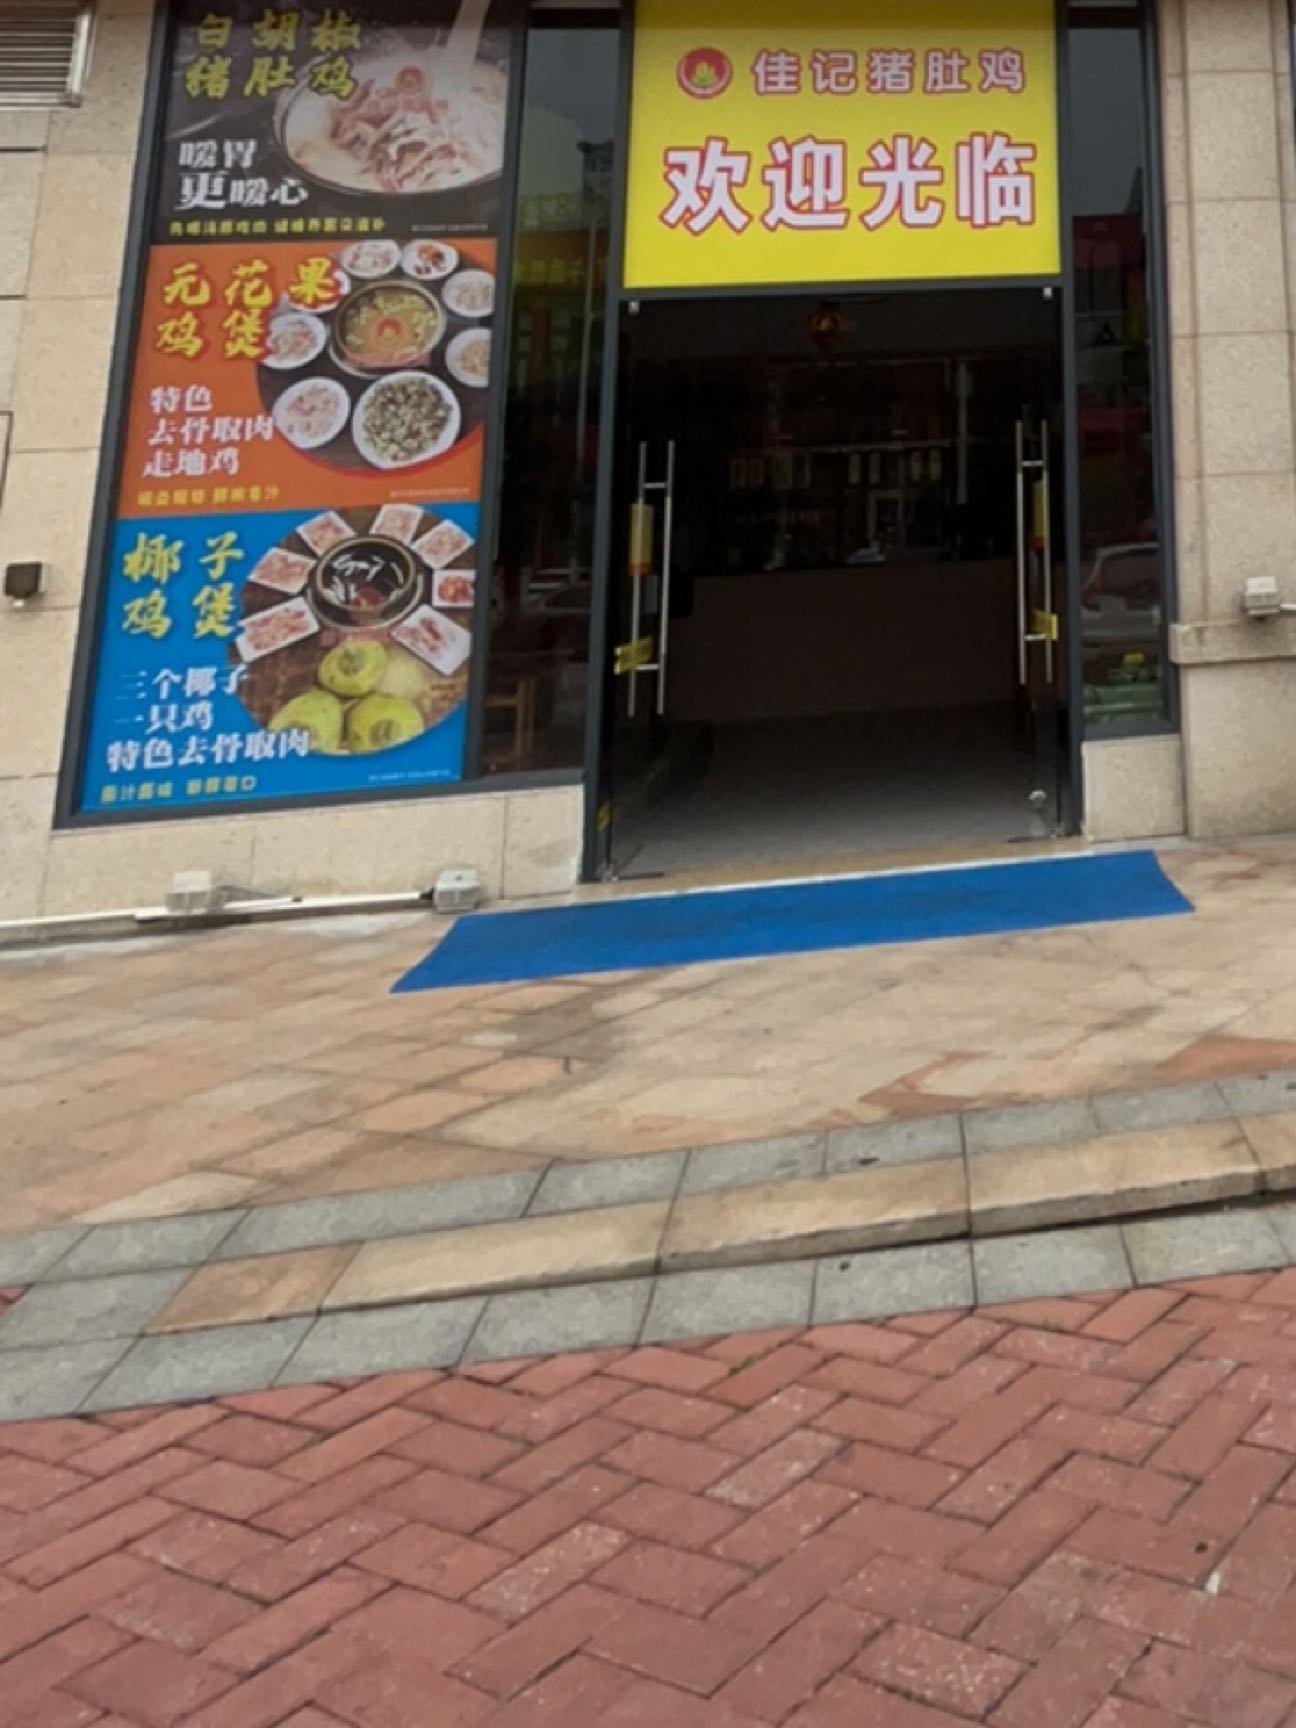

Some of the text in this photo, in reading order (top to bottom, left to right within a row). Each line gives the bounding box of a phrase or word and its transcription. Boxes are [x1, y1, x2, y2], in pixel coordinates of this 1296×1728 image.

[185, 55, 357, 101] 猪肚鸡
[751, 48, 1026, 95] 佳记猪肚鸡
[659, 132, 1037, 235] 欢迎光临
[156, 308, 266, 359] 鸡煲
[122, 531, 244, 582] 椰子
[121, 580, 239, 639] 鸡煲
